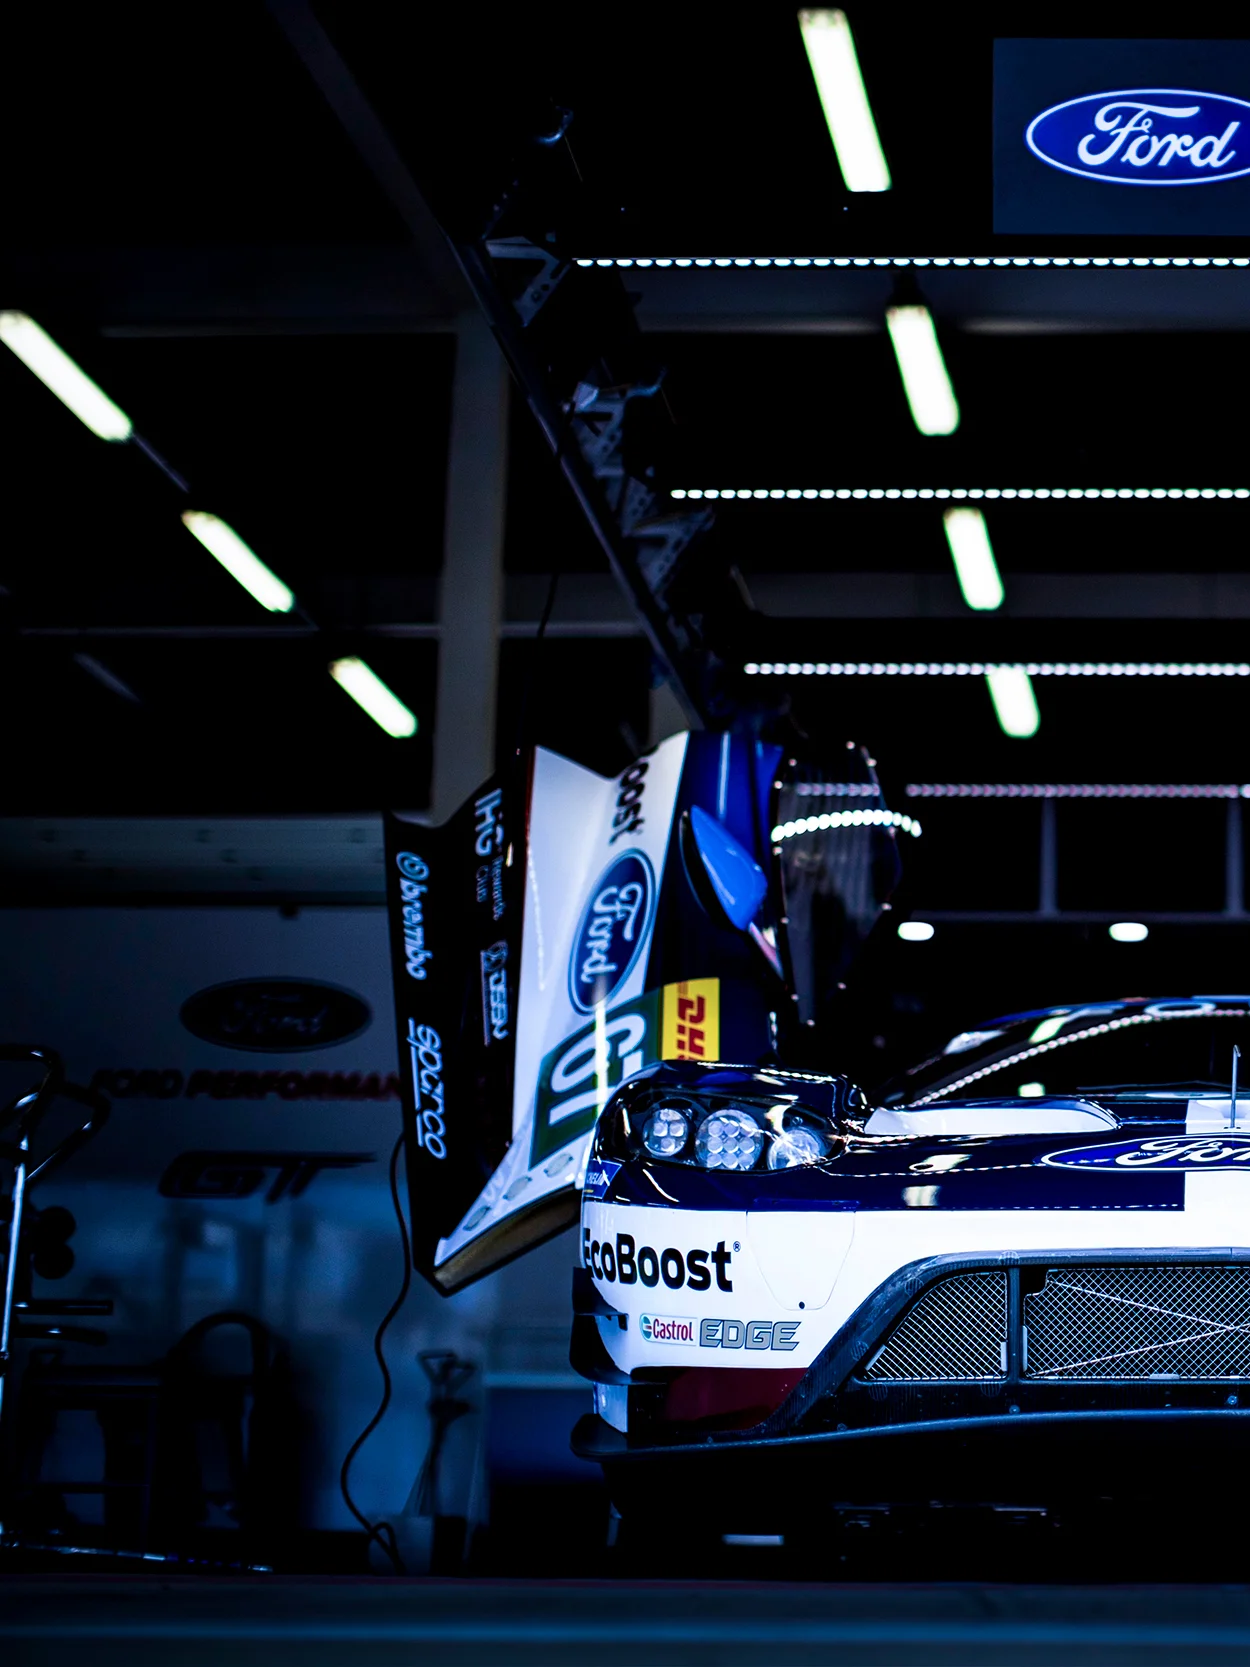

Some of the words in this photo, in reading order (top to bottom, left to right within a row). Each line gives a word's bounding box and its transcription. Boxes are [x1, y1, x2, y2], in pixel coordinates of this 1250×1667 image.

[1077, 101, 1240, 168] Ford
[474, 787, 504, 857] IHG
[400, 876, 435, 982] brembo
[579, 880, 645, 984] Ford
[677, 994, 705, 1060] DH
[407, 1017, 448, 1161] sparco
[583, 1227, 733, 1293] EcoBoost
[653, 1318, 694, 1341] Castrol
[699, 1318, 802, 1351] EDGE
